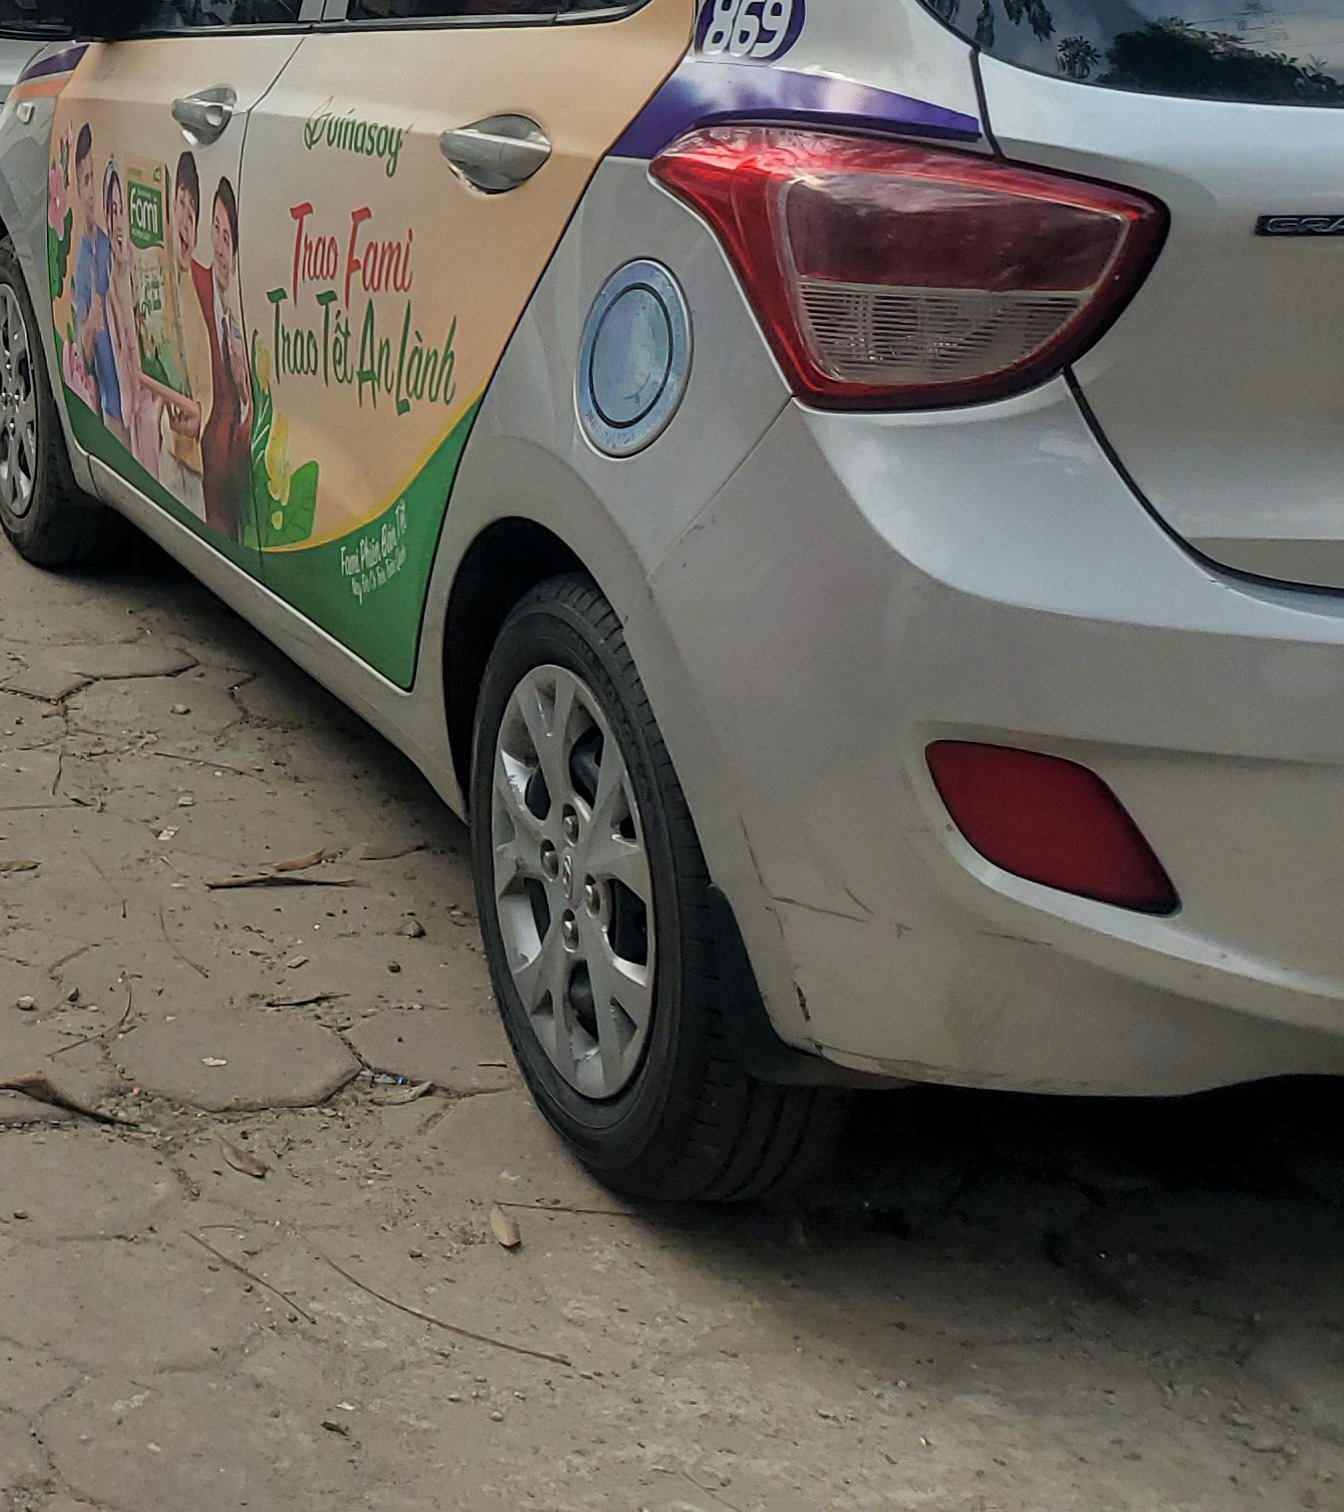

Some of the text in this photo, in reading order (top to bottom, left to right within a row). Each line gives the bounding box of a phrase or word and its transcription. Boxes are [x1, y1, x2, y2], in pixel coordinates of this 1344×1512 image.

[289, 201, 413, 311] Trao Fami
[266, 287, 456, 416] Trao Tết An Lành
